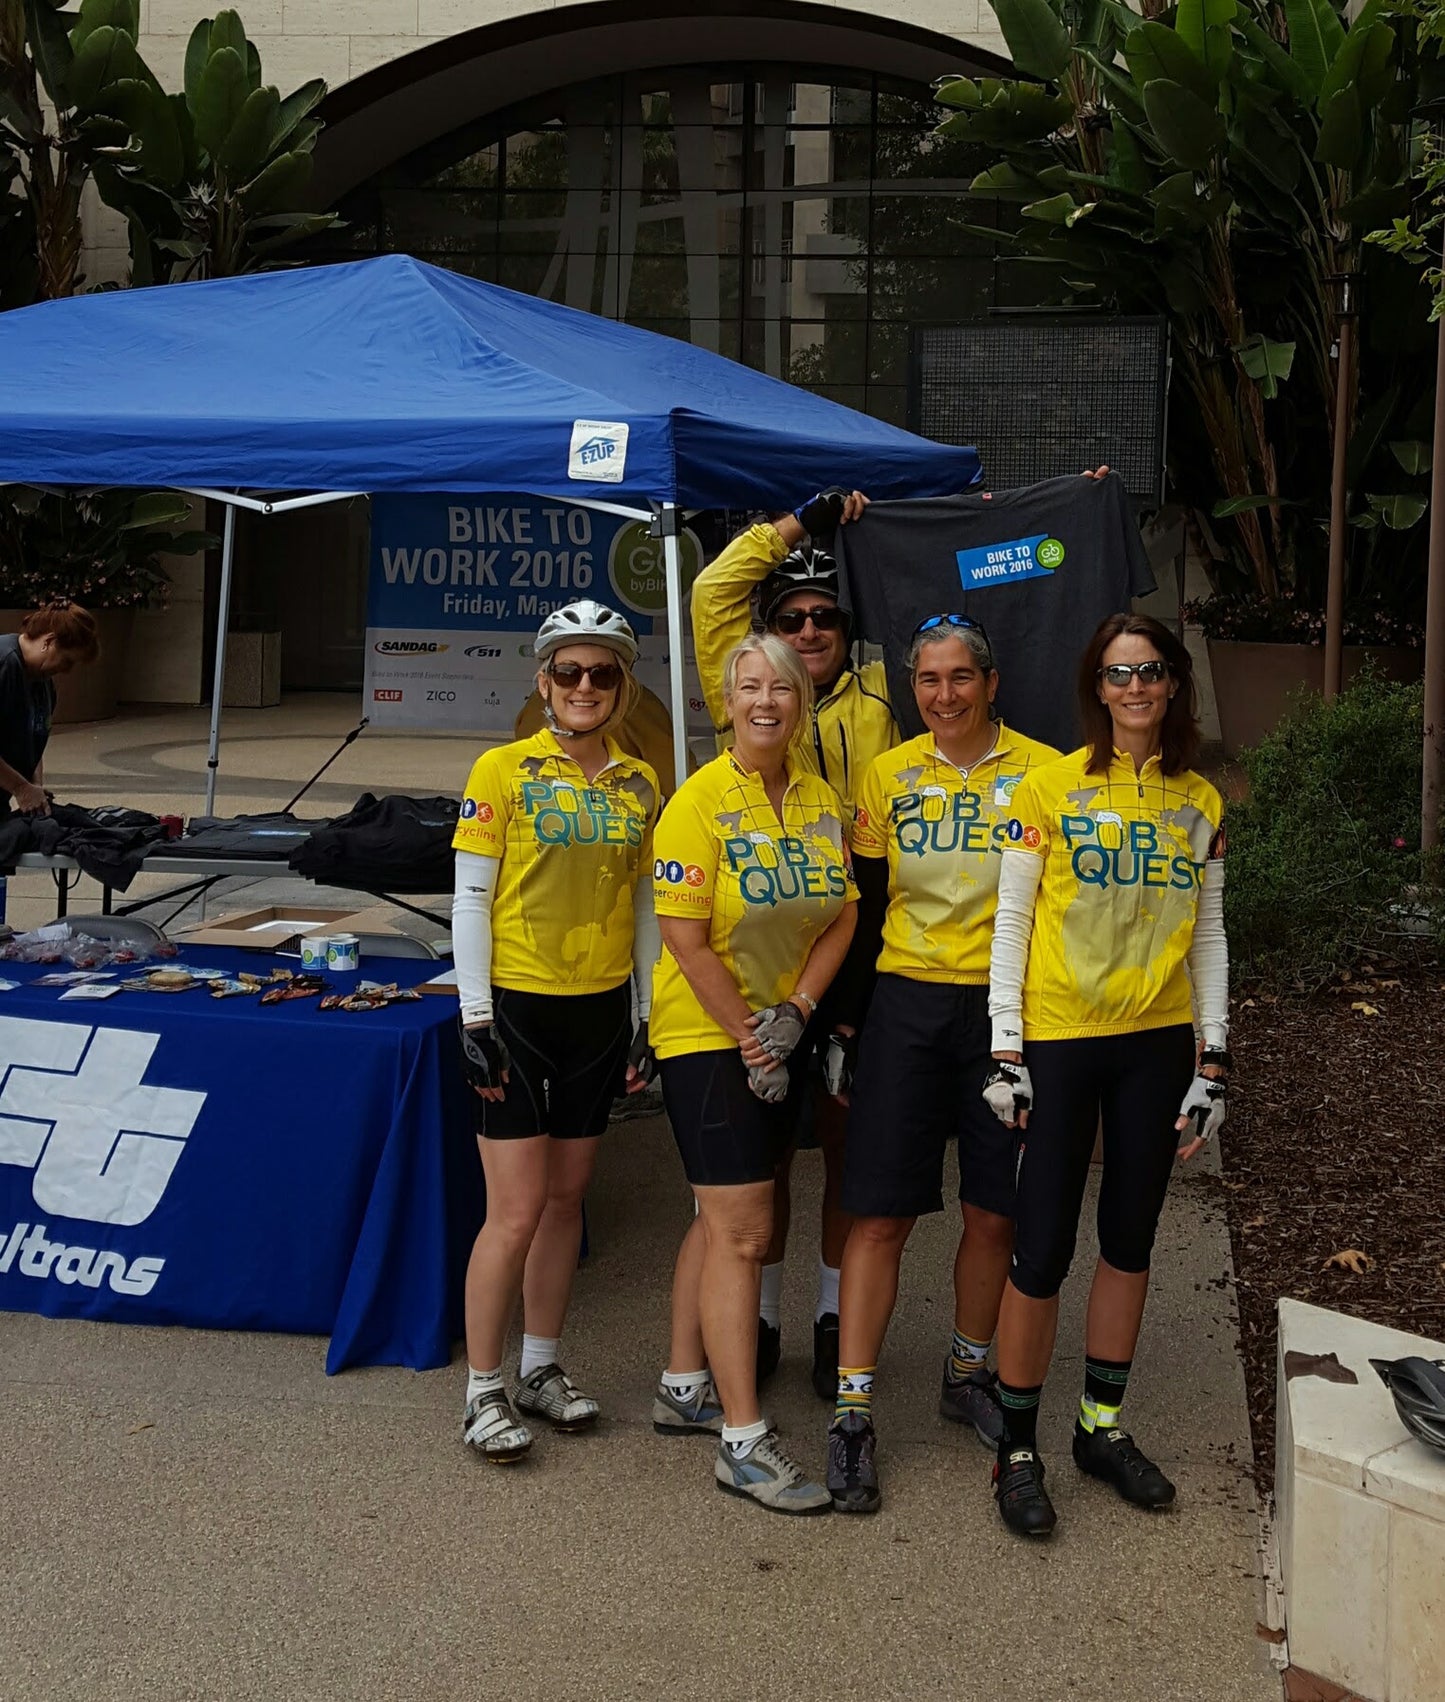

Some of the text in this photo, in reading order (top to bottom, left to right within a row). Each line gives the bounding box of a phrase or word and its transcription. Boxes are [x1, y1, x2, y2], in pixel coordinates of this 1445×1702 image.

[447, 506, 592, 545] BIKE TO
[986, 545, 1031, 564] BIKE TO
[381, 547, 594, 589] WORK 2016
[971, 558, 1033, 580] WORK 2016
[443, 592, 510, 620] Friday,
[381, 641, 438, 651] SANDAG
[477, 648, 502, 657] 511
[378, 690, 401, 700] CLIF
[426, 690, 456, 702] ZICO
[534, 808, 646, 848] QUES
[1071, 845, 1205, 890] QUEST
